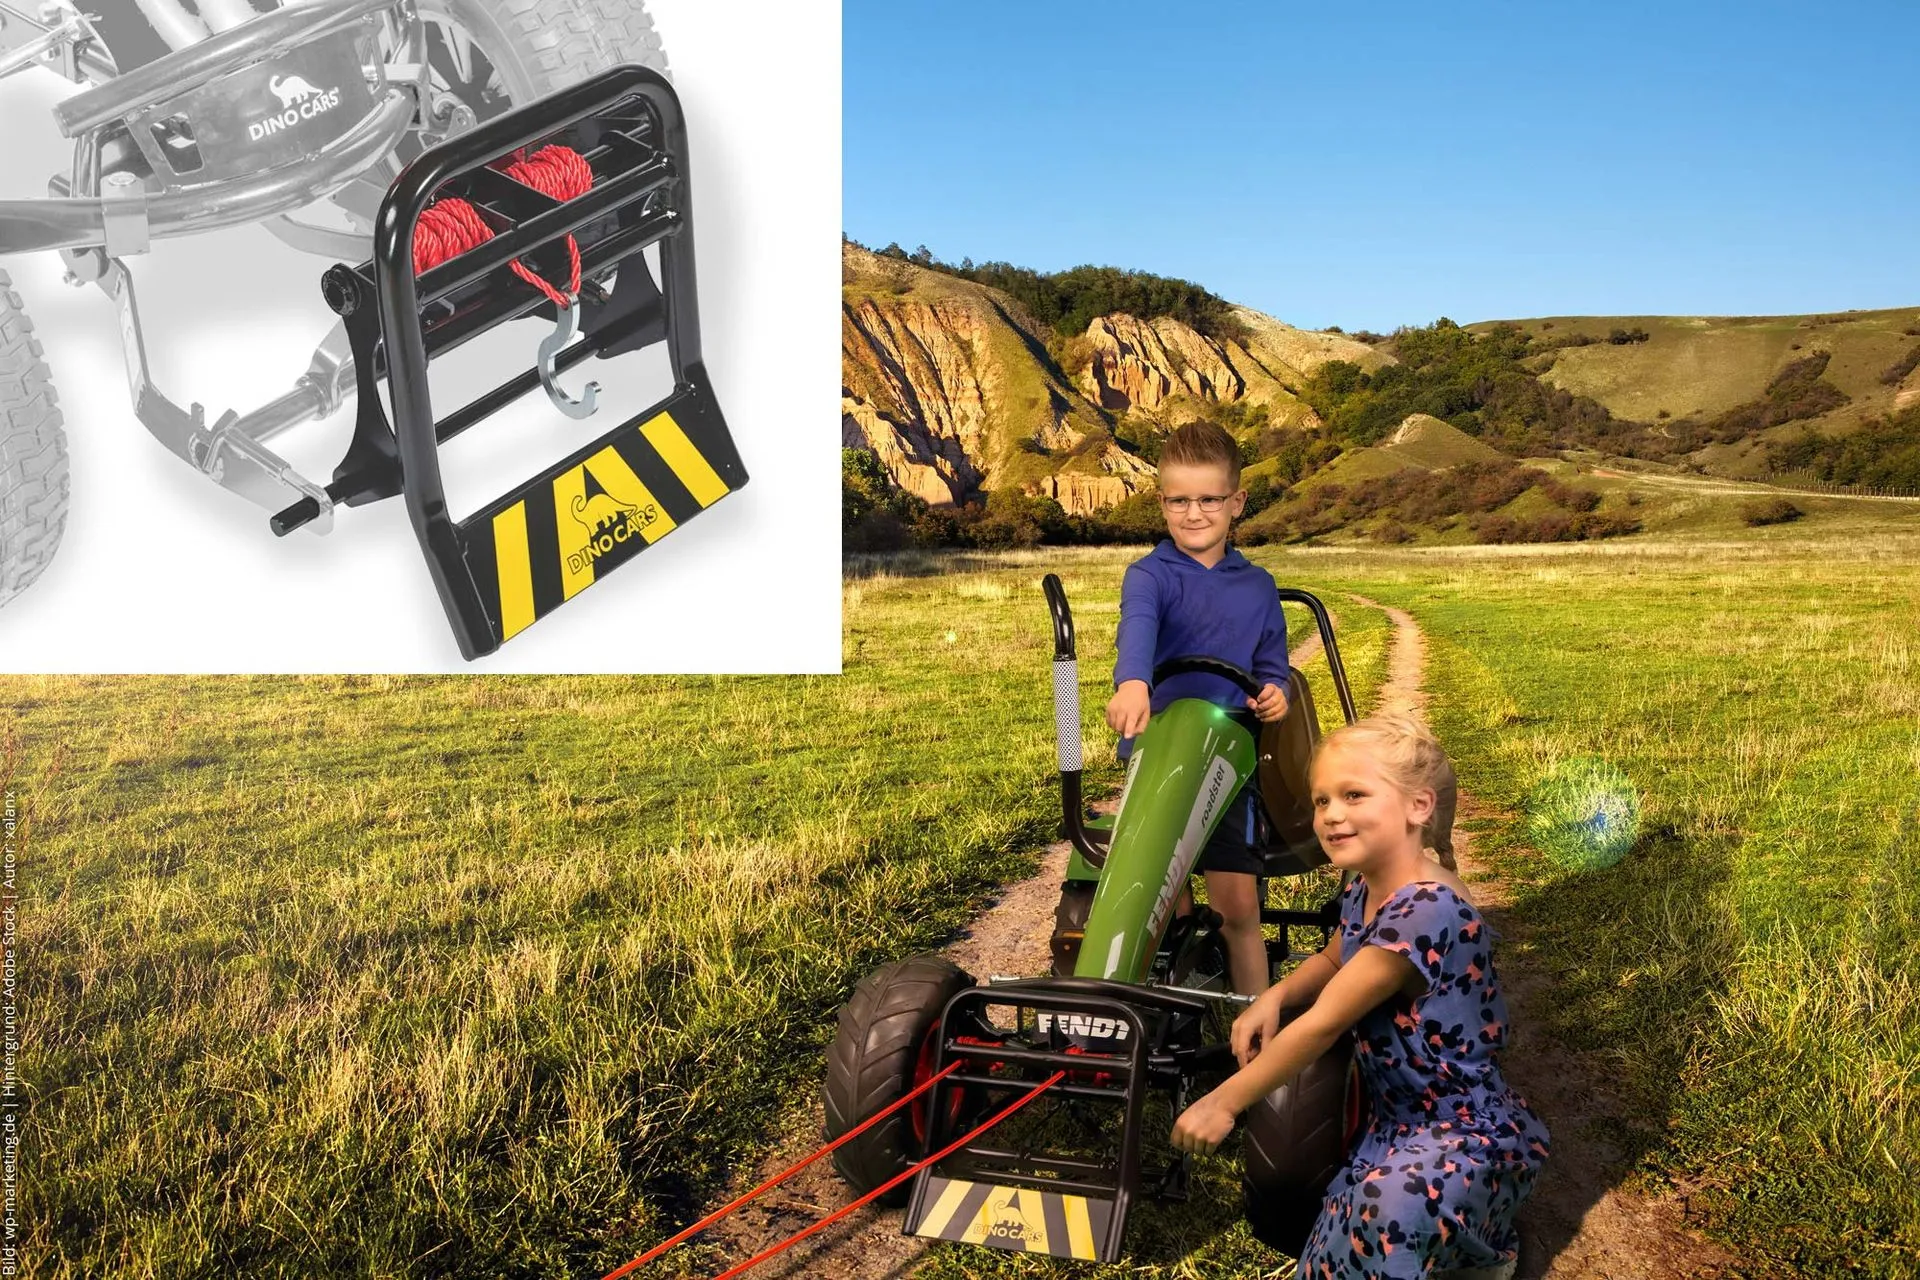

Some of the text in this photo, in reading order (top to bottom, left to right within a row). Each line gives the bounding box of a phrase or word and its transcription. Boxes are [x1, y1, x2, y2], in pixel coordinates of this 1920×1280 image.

[248, 86, 340, 141] DINO CARS
[567, 504, 658, 576] DINO CARS
[1201, 764, 1225, 829] roadster
[1038, 1013, 1130, 1040] FENDT
[973, 1223, 1043, 1243] DINO CARS
